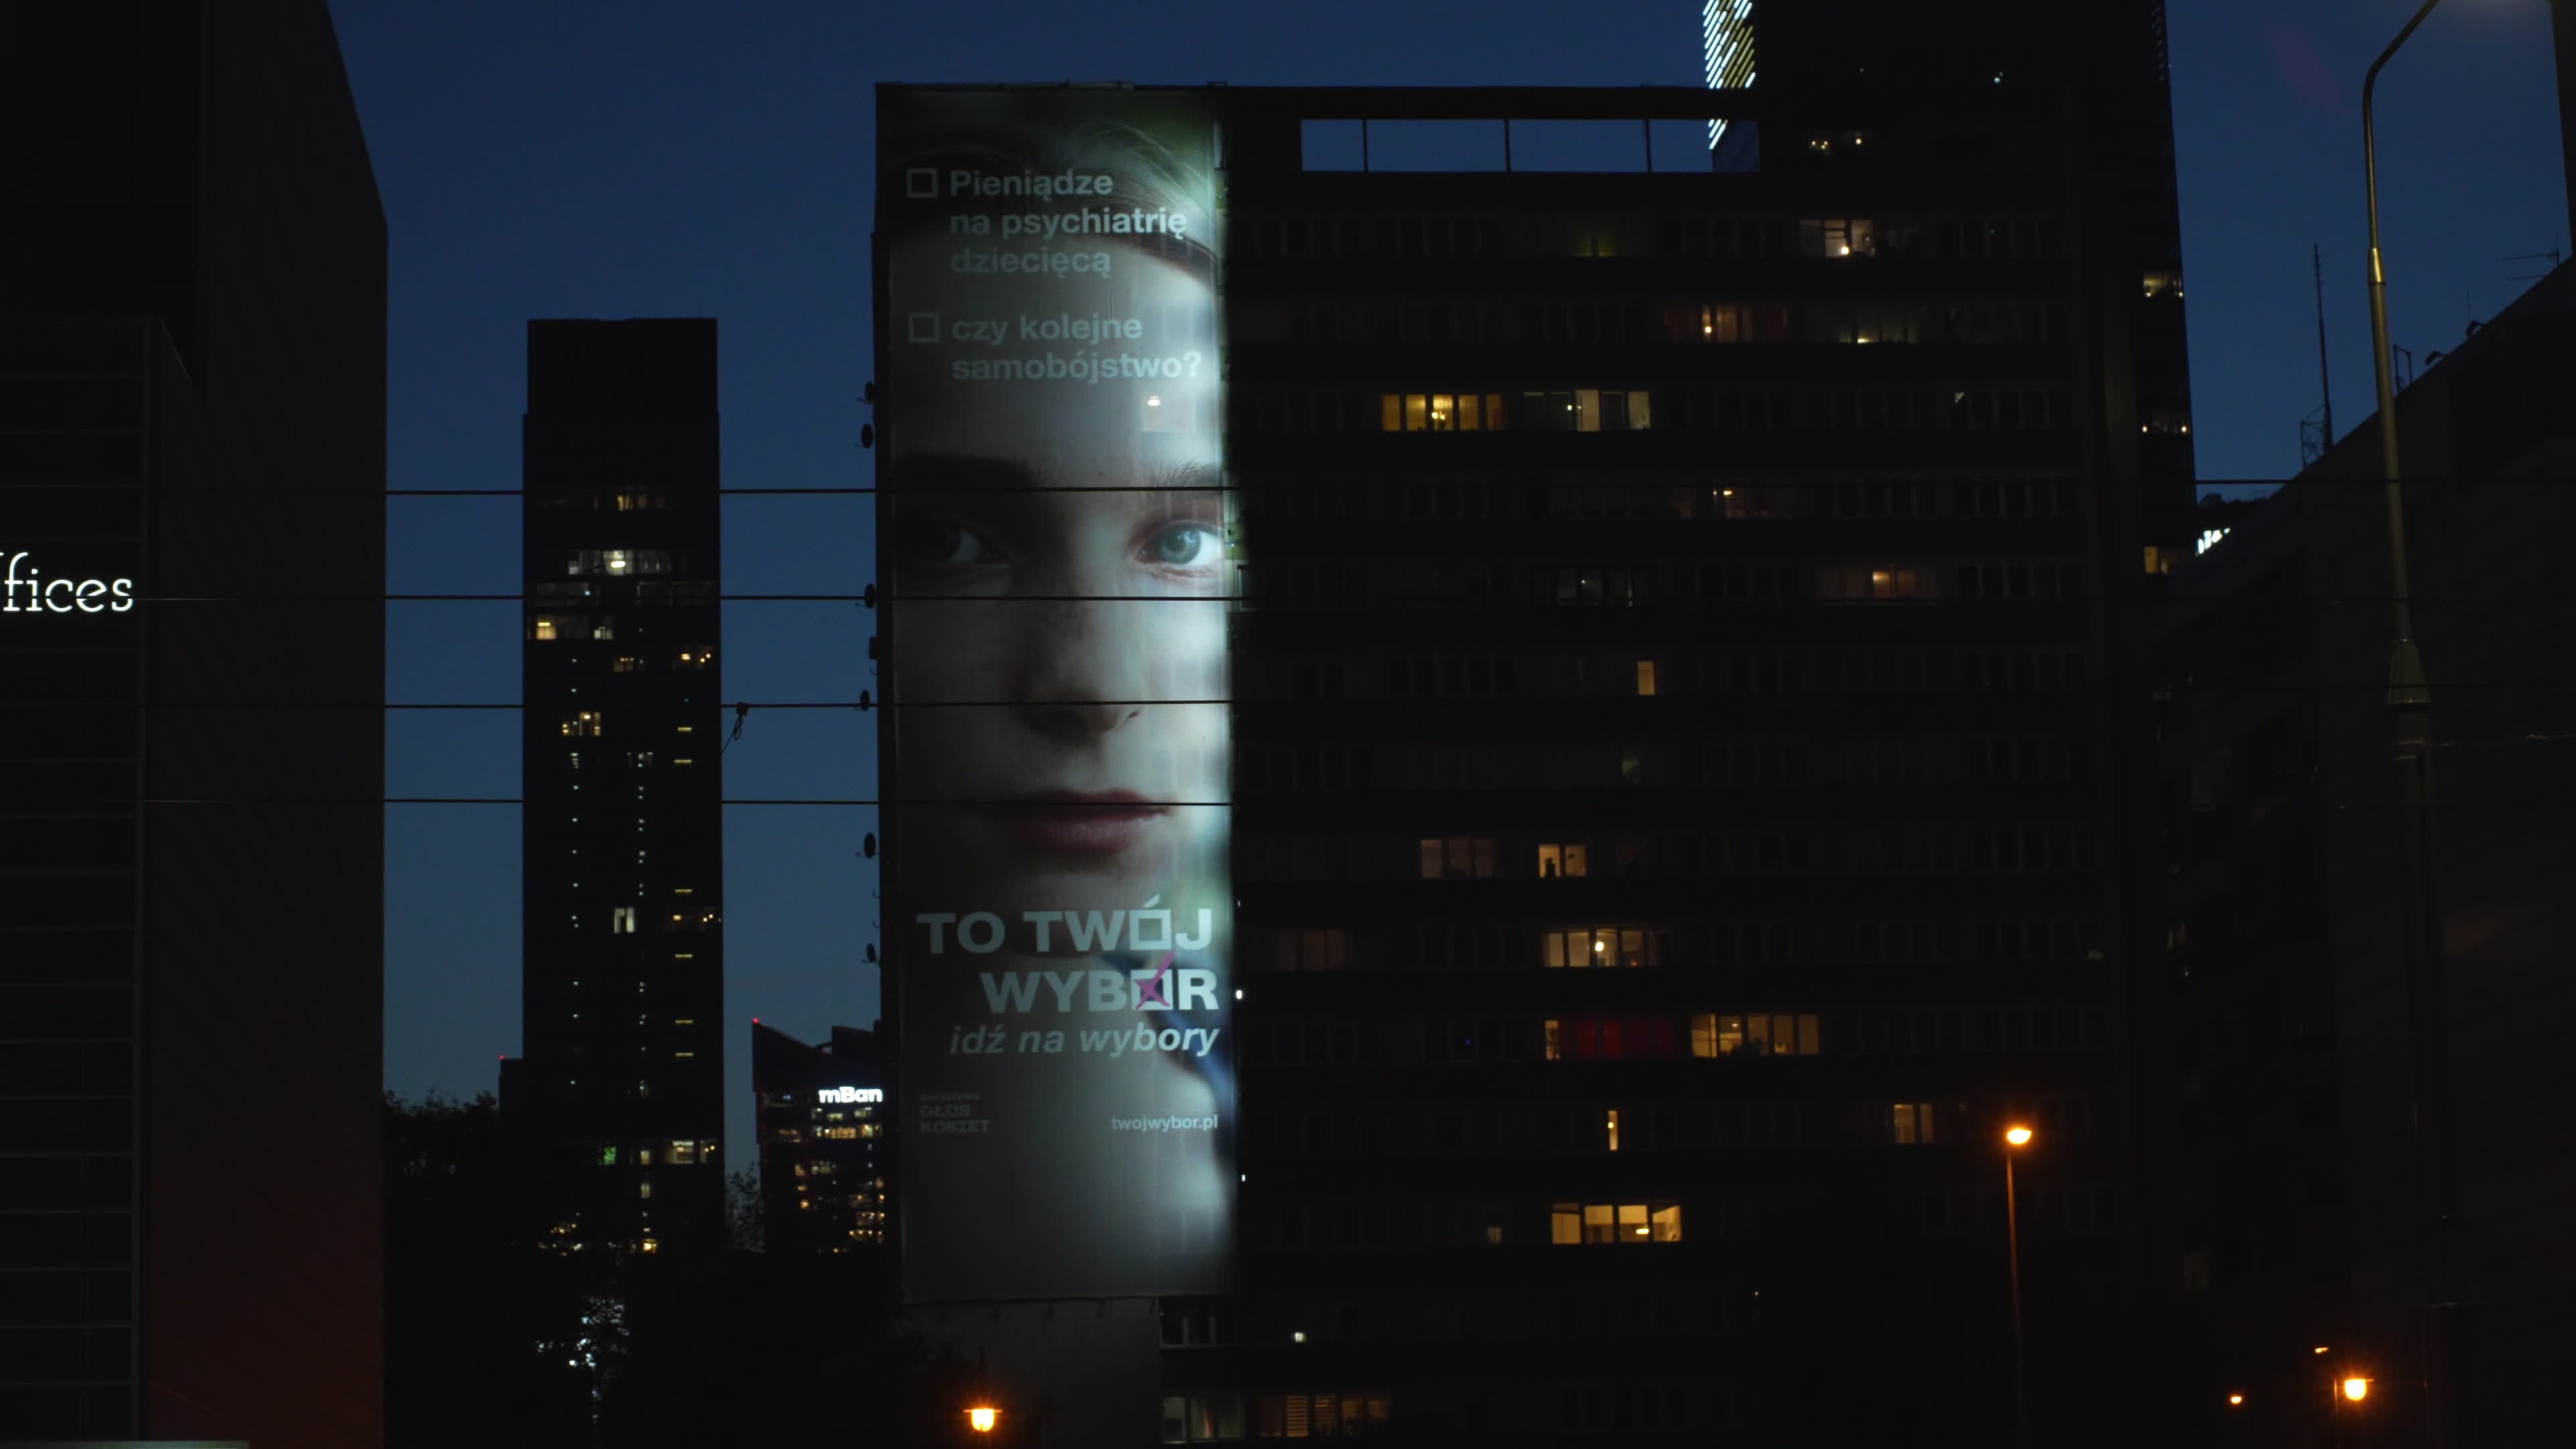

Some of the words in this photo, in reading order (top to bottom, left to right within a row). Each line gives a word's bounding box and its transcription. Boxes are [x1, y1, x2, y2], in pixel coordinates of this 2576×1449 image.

[949, 169, 1114, 201] Pieniądze
[950, 214, 990, 234] na
[1002, 207, 1187, 240] psychiatrię
[950, 247, 1112, 278] dziecięcą
[952, 319, 1009, 345] czy
[1020, 314, 1142, 345] kolejne
[953, 350, 1202, 384] samobójstwo?
[0, 551, 133, 612] fices
[916, 912, 1006, 955] TO
[1023, 894, 1213, 953] TWÓJ
[950, 1024, 1006, 1055] idź
[1018, 1028, 1065, 1053] na
[1079, 1022, 1220, 1058] wybory
[1112, 1114, 1218, 1132] twojwybor.pl
